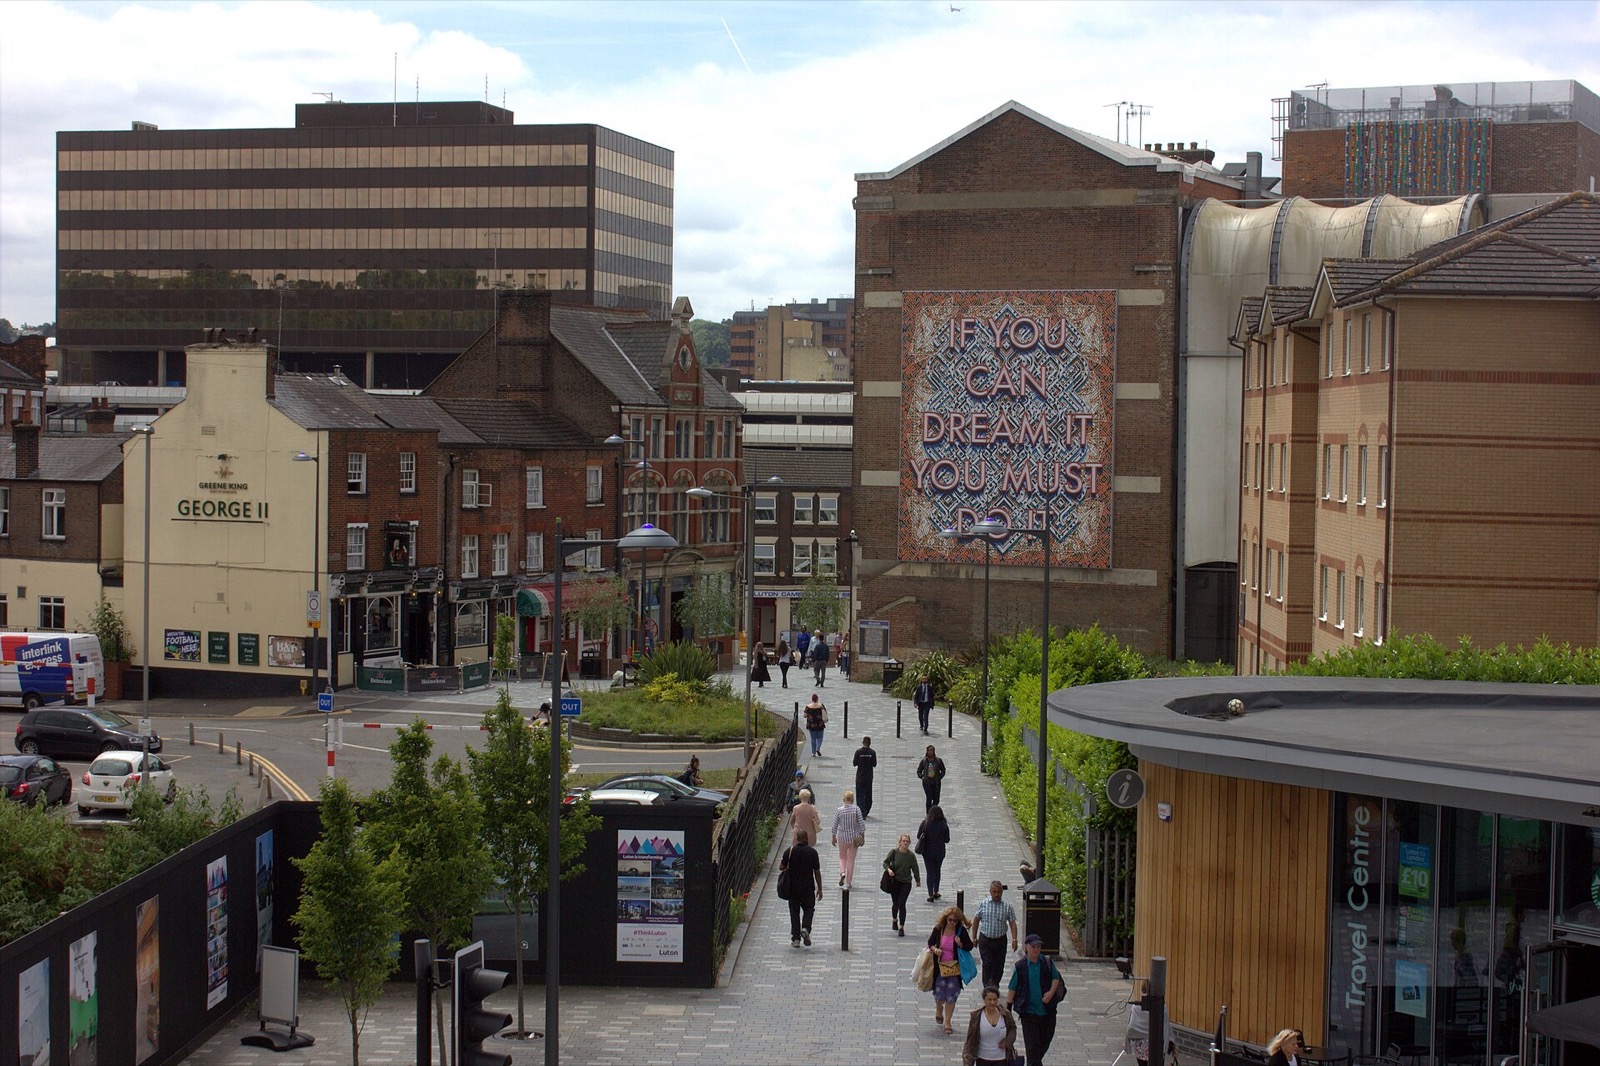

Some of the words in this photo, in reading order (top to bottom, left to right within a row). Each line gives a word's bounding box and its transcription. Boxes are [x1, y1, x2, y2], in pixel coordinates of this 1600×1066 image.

[948, 316, 978, 350] IF
[988, 316, 1068, 350] YOU
[965, 365, 1049, 398] CAN
[922, 412, 1050, 446] DREAM
[1065, 413, 1094, 447] IT
[199, 482, 227, 490] GREENE
[910, 459, 987, 492] YOU
[1001, 462, 1103, 495] MUST
[178, 500, 251, 518] GEORGE
[258, 502, 268, 518] II
[22, 641, 63, 660] interlink
[166, 635, 200, 646] FOOTBALL
[320, 698, 330, 706] OUT
[1347, 805, 1371, 911] Centre
[1401, 867, 1429, 888] £10
[1345, 922, 1368, 1009] Travel
